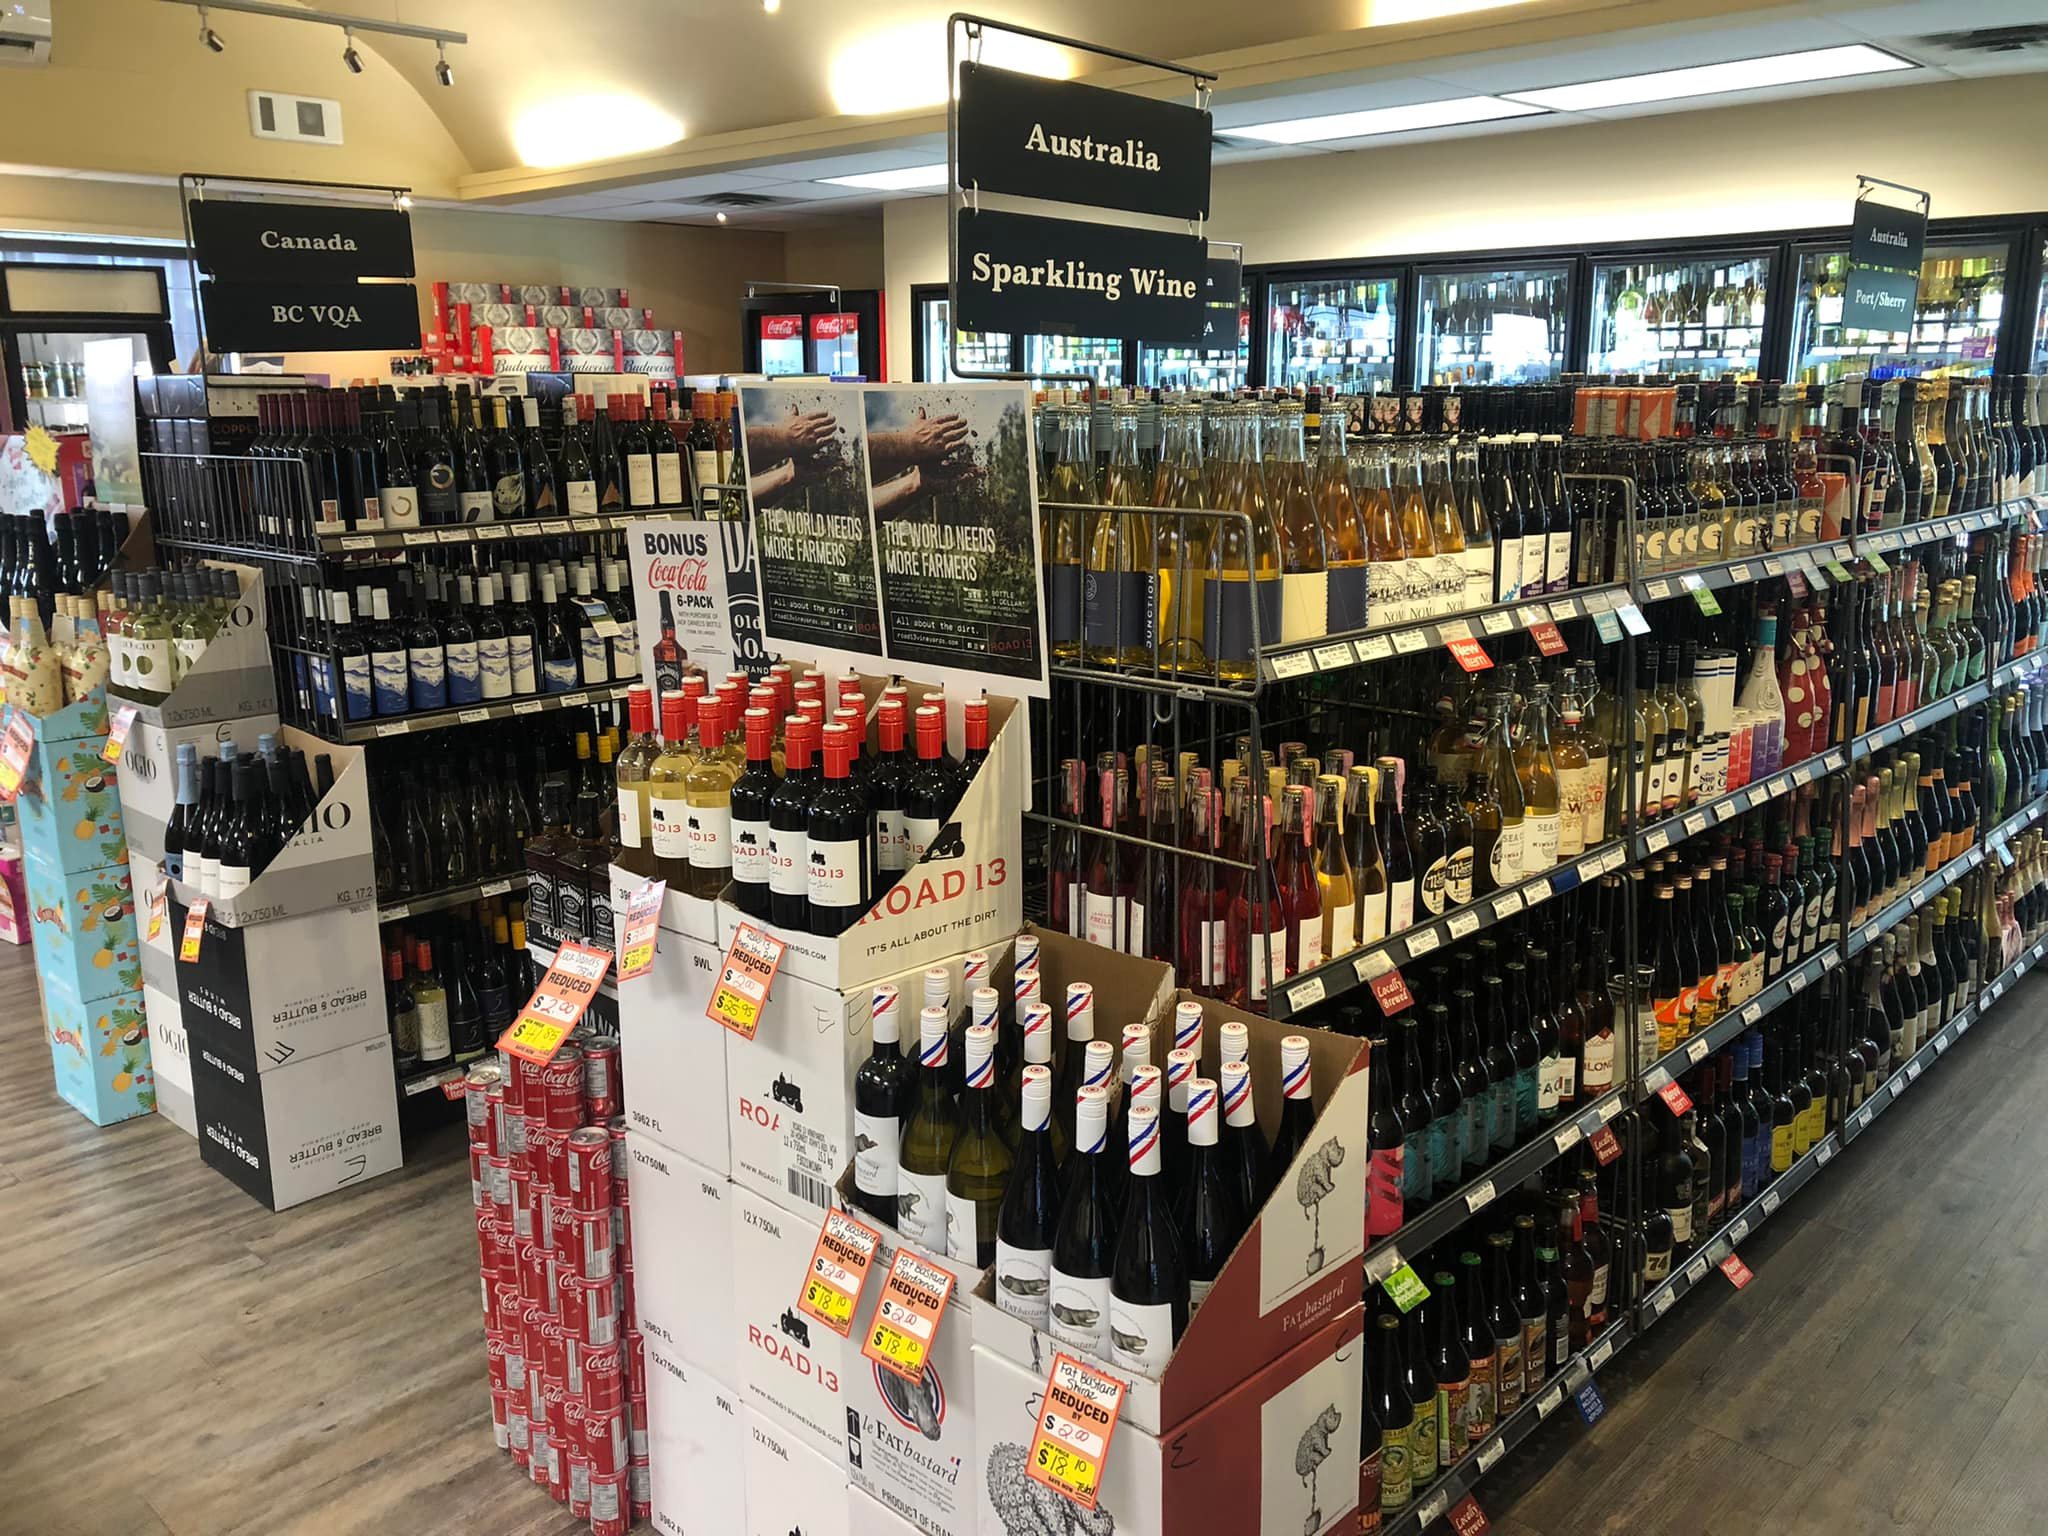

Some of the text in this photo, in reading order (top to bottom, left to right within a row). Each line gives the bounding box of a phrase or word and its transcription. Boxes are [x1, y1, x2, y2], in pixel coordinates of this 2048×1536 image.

[1025, 123, 1161, 171] Australia
[261, 230, 358, 251] Canada
[1870, 227, 1909, 249] Australia
[973, 253, 1197, 300] Sparkling Wine
[1855, 289, 1908, 312] Port/Sherry
[272, 305, 362, 329] BC VQA
[761, 507, 862, 541] THE WORLD NEEDS
[883, 520, 995, 553] THE WORLD NEEDS
[763, 535, 847, 568] MORE FARMERS
[648, 557, 709, 591] Coca-Cola
[885, 549, 977, 581] MORE FARMERS
[677, 594, 714, 609] 6-PACK
[774, 598, 849, 617] All about the dirt.
[1145, 575, 1154, 649] JUNCTION
[896, 616, 979, 636] All about the dirt.
[990, 641, 1021, 652] ROAD
[1451, 643, 1479, 657] New
[738, 664, 769, 676] BRAND
[125, 750, 157, 781] OGIO
[668, 824, 681, 834] 13
[703, 833, 717, 843] 13
[779, 857, 793, 868] 13
[830, 869, 844, 880] 13
[975, 857, 1008, 891] 13
[629, 905, 658, 922] REDUCED
[626, 932, 632, 944] $
[866, 910, 999, 957] IT'S ALL ABOUT THE DIRT.
[694, 955, 713, 972] 9WL
[732, 948, 771, 976] REDUCED
[547, 971, 592, 994] REDUCED
[725, 969, 733, 980] $
[1377, 977, 1403, 998] Locally
[1382, 987, 1409, 1009] Brewed
[330, 990, 368, 1009] BREAD
[533, 995, 544, 1009] $
[716, 995, 725, 1008] $
[272, 1003, 318, 1024] BUTTER
[514, 1023, 526, 1038] $
[1661, 1087, 1681, 1101] New
[632, 1109, 663, 1133] 3962 FL
[346, 1124, 384, 1144] BREAD
[289, 1143, 335, 1164] BUTTER
[633, 1149, 670, 1177] 12x750ML
[702, 1182, 720, 1201] 9WL
[822, 1235, 866, 1268] REDUCED
[837, 1256, 845, 1264] BY
[815, 1257, 824, 1272] $
[1648, 1255, 1669, 1272] 74
[808, 1286, 816, 1301] $
[889, 1277, 939, 1310] REDUCED
[906, 1299, 915, 1308] BY
[1304, 1279, 1345, 1318] bastard
[882, 1301, 892, 1315] $
[643, 1319, 673, 1344] 3962 FL
[873, 1330, 884, 1346] $
[650, 1351, 687, 1383] 12x750ML
[749, 1323, 839, 1394] ROAD 13
[1060, 1362, 1077, 1379] Fat
[1051, 1387, 1109, 1425] REDUCED
[1072, 1412, 1081, 1421] BY
[1044, 1414, 1055, 1430] $
[1038, 1447, 1049, 1466] $
[1074, 1457, 1087, 1472] 10
[1043, 1441, 1070, 1459] NEW PRICE
[903, 1440, 958, 1487] bastard
[1048, 1475, 1073, 1493] SAVE NOW
[882, 1488, 929, 1528] PRODUCT OF
[1455, 1503, 1479, 1531] Locally
